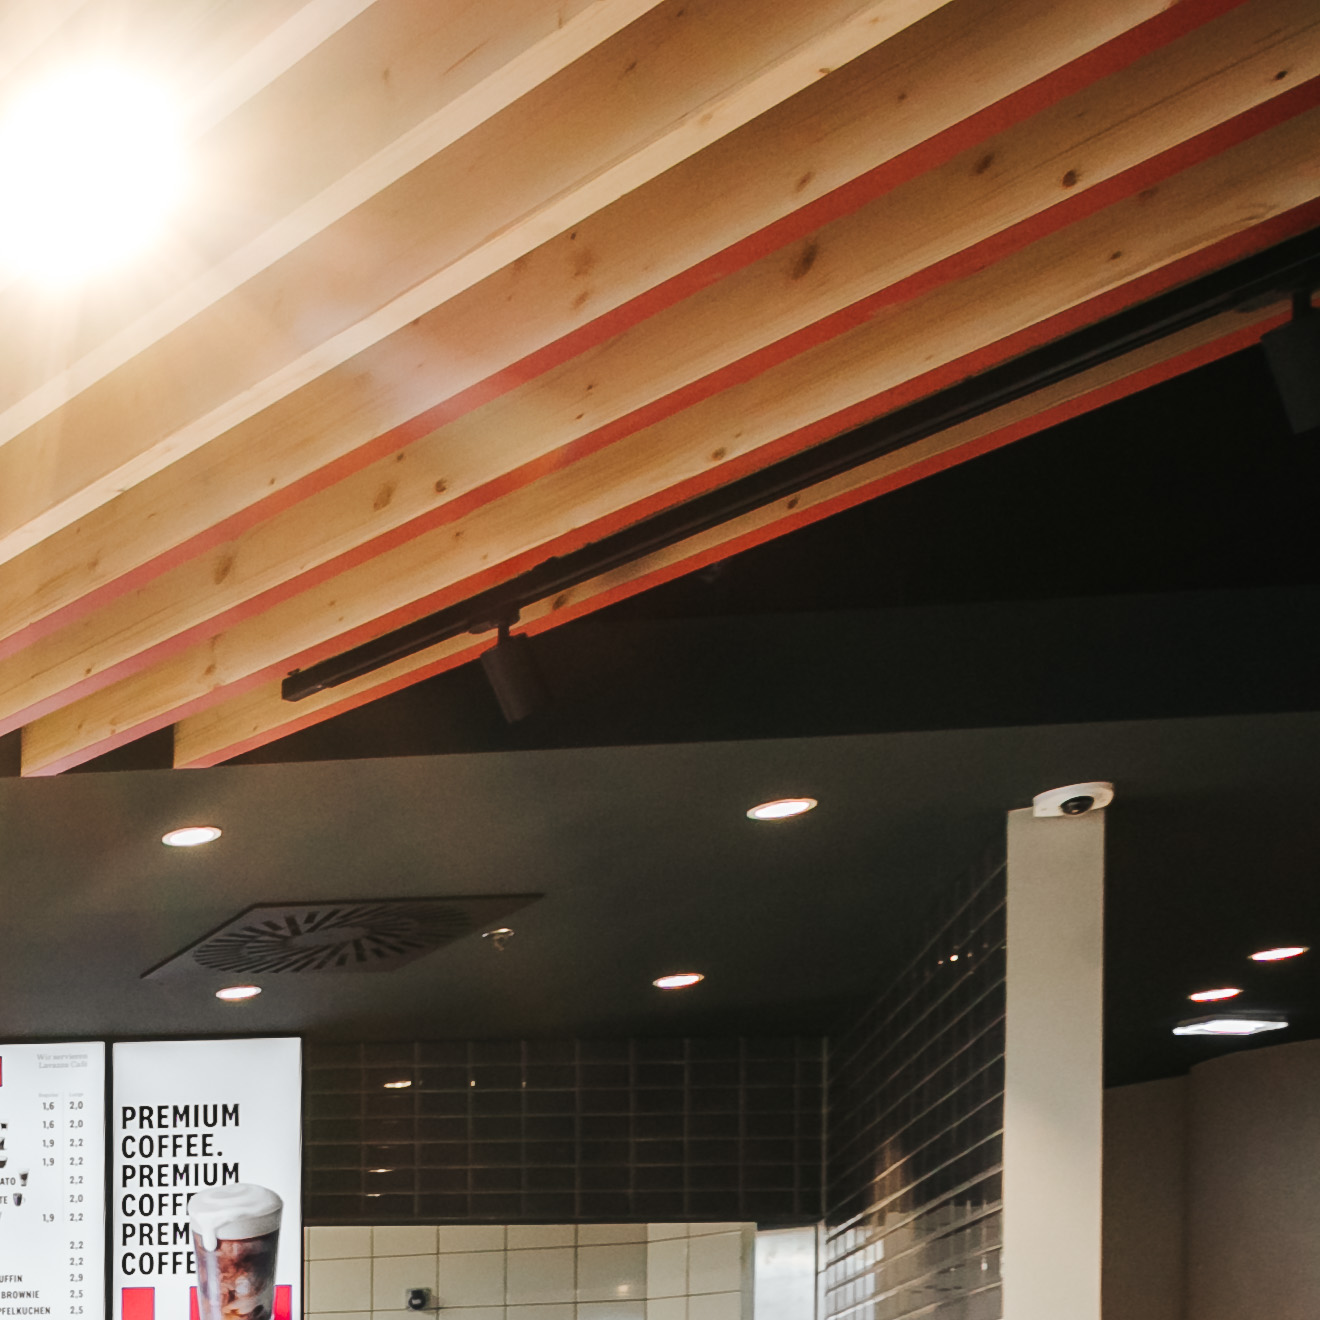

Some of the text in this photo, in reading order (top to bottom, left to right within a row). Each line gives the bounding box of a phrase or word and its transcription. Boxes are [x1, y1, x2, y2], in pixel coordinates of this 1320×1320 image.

[43, 1102, 54, 1111] 1,6
[69, 1101, 83, 1110] 2,0
[121, 1103, 240, 1129] PREMIUM
[43, 1120, 54, 1129] 1,6
[69, 1120, 83, 1129] 2,0
[43, 1139, 54, 1148] 1,9
[69, 1138, 83, 1147] 2,2
[121, 1133, 223, 1159] COFFEE.
[43, 1158, 54, 1166] 1,9
[69, 1157, 83, 1166] 2,2
[121, 1162, 240, 1187] PREMIUM
[69, 1176, 83, 1184] 2,2
[69, 1194, 83, 1203] 2,0
[121, 1193, 197, 1217] COFF
[43, 1214, 54, 1223] 1,9
[69, 1213, 83, 1222] 2,2
[121, 1222, 190, 1246] PREM
[69, 1241, 83, 1250] 2,2
[69, 1257, 83, 1266] 2,2
[121, 1252, 196, 1275] COFFE
[69, 1274, 83, 1282] 2,9
[1, 1290, 40, 1299] BROWNIE
[69, 1290, 83, 1298] 2,5
[69, 1306, 83, 1314] 2,5
